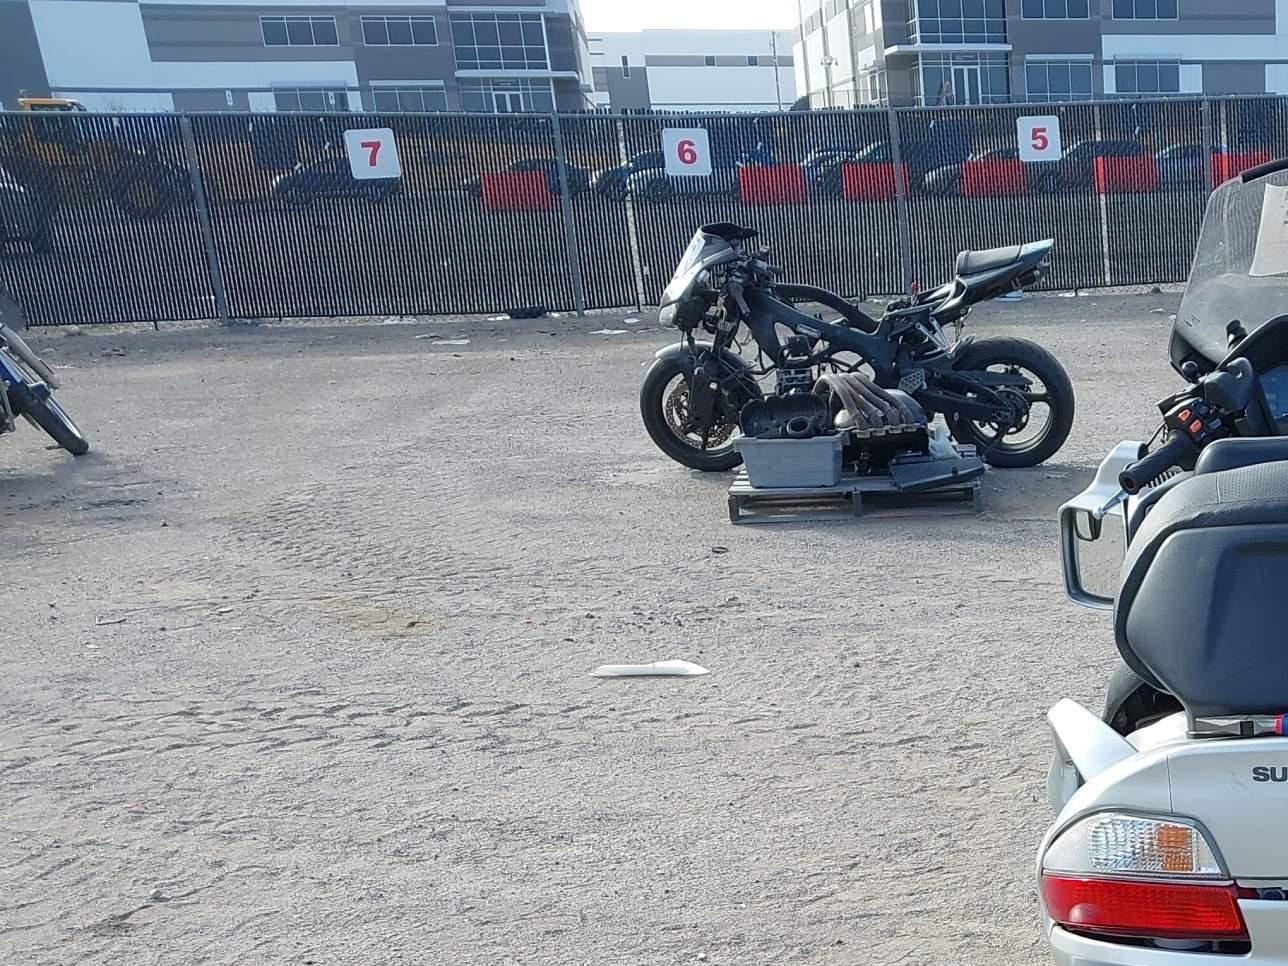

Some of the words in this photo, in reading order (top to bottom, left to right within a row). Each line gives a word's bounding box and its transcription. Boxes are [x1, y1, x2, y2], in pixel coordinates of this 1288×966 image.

[677, 139, 697, 165] 6
[1031, 127, 1049, 151] 5
[361, 140, 381, 167] 7
